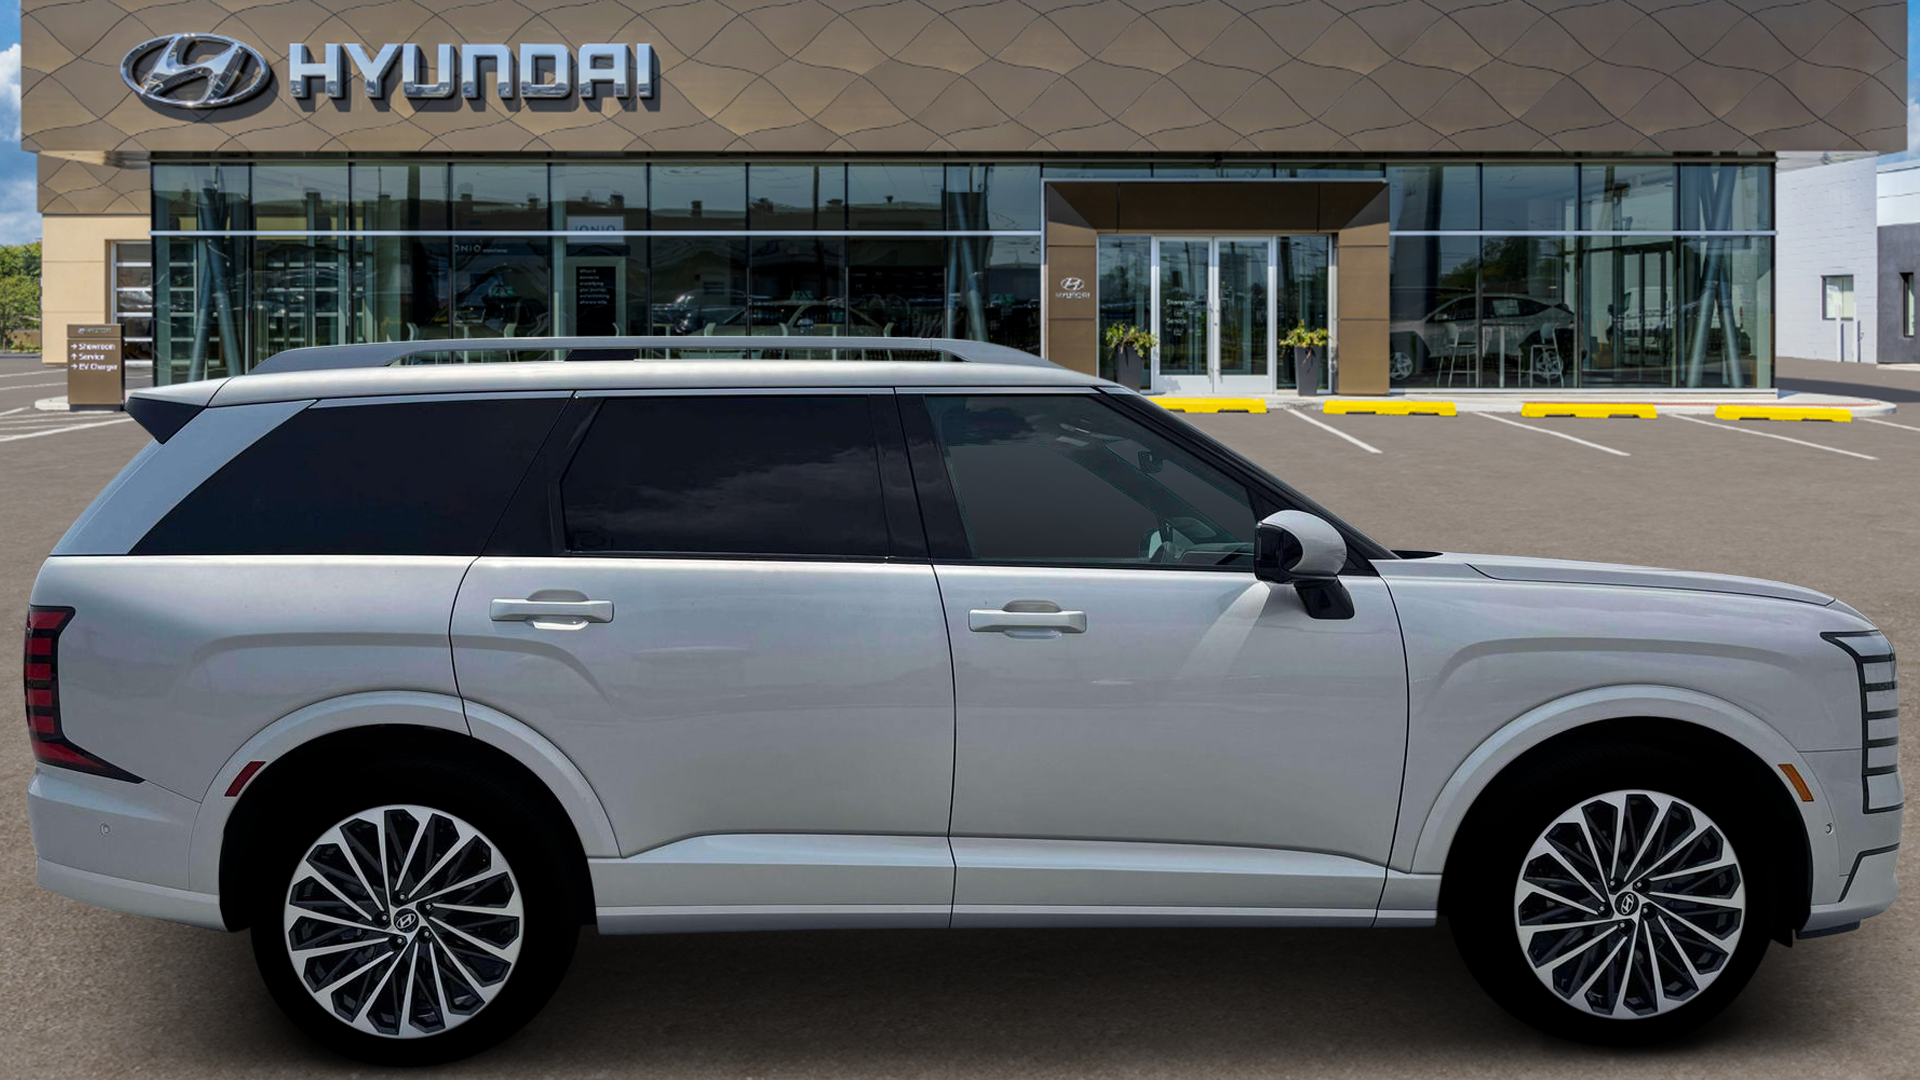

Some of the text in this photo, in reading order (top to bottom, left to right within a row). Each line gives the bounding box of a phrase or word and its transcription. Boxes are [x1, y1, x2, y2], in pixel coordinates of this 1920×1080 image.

[289, 43, 654, 99] HYUNDAI
[78, 343, 116, 351] Showroom
[90, 363, 118, 372] Charger
